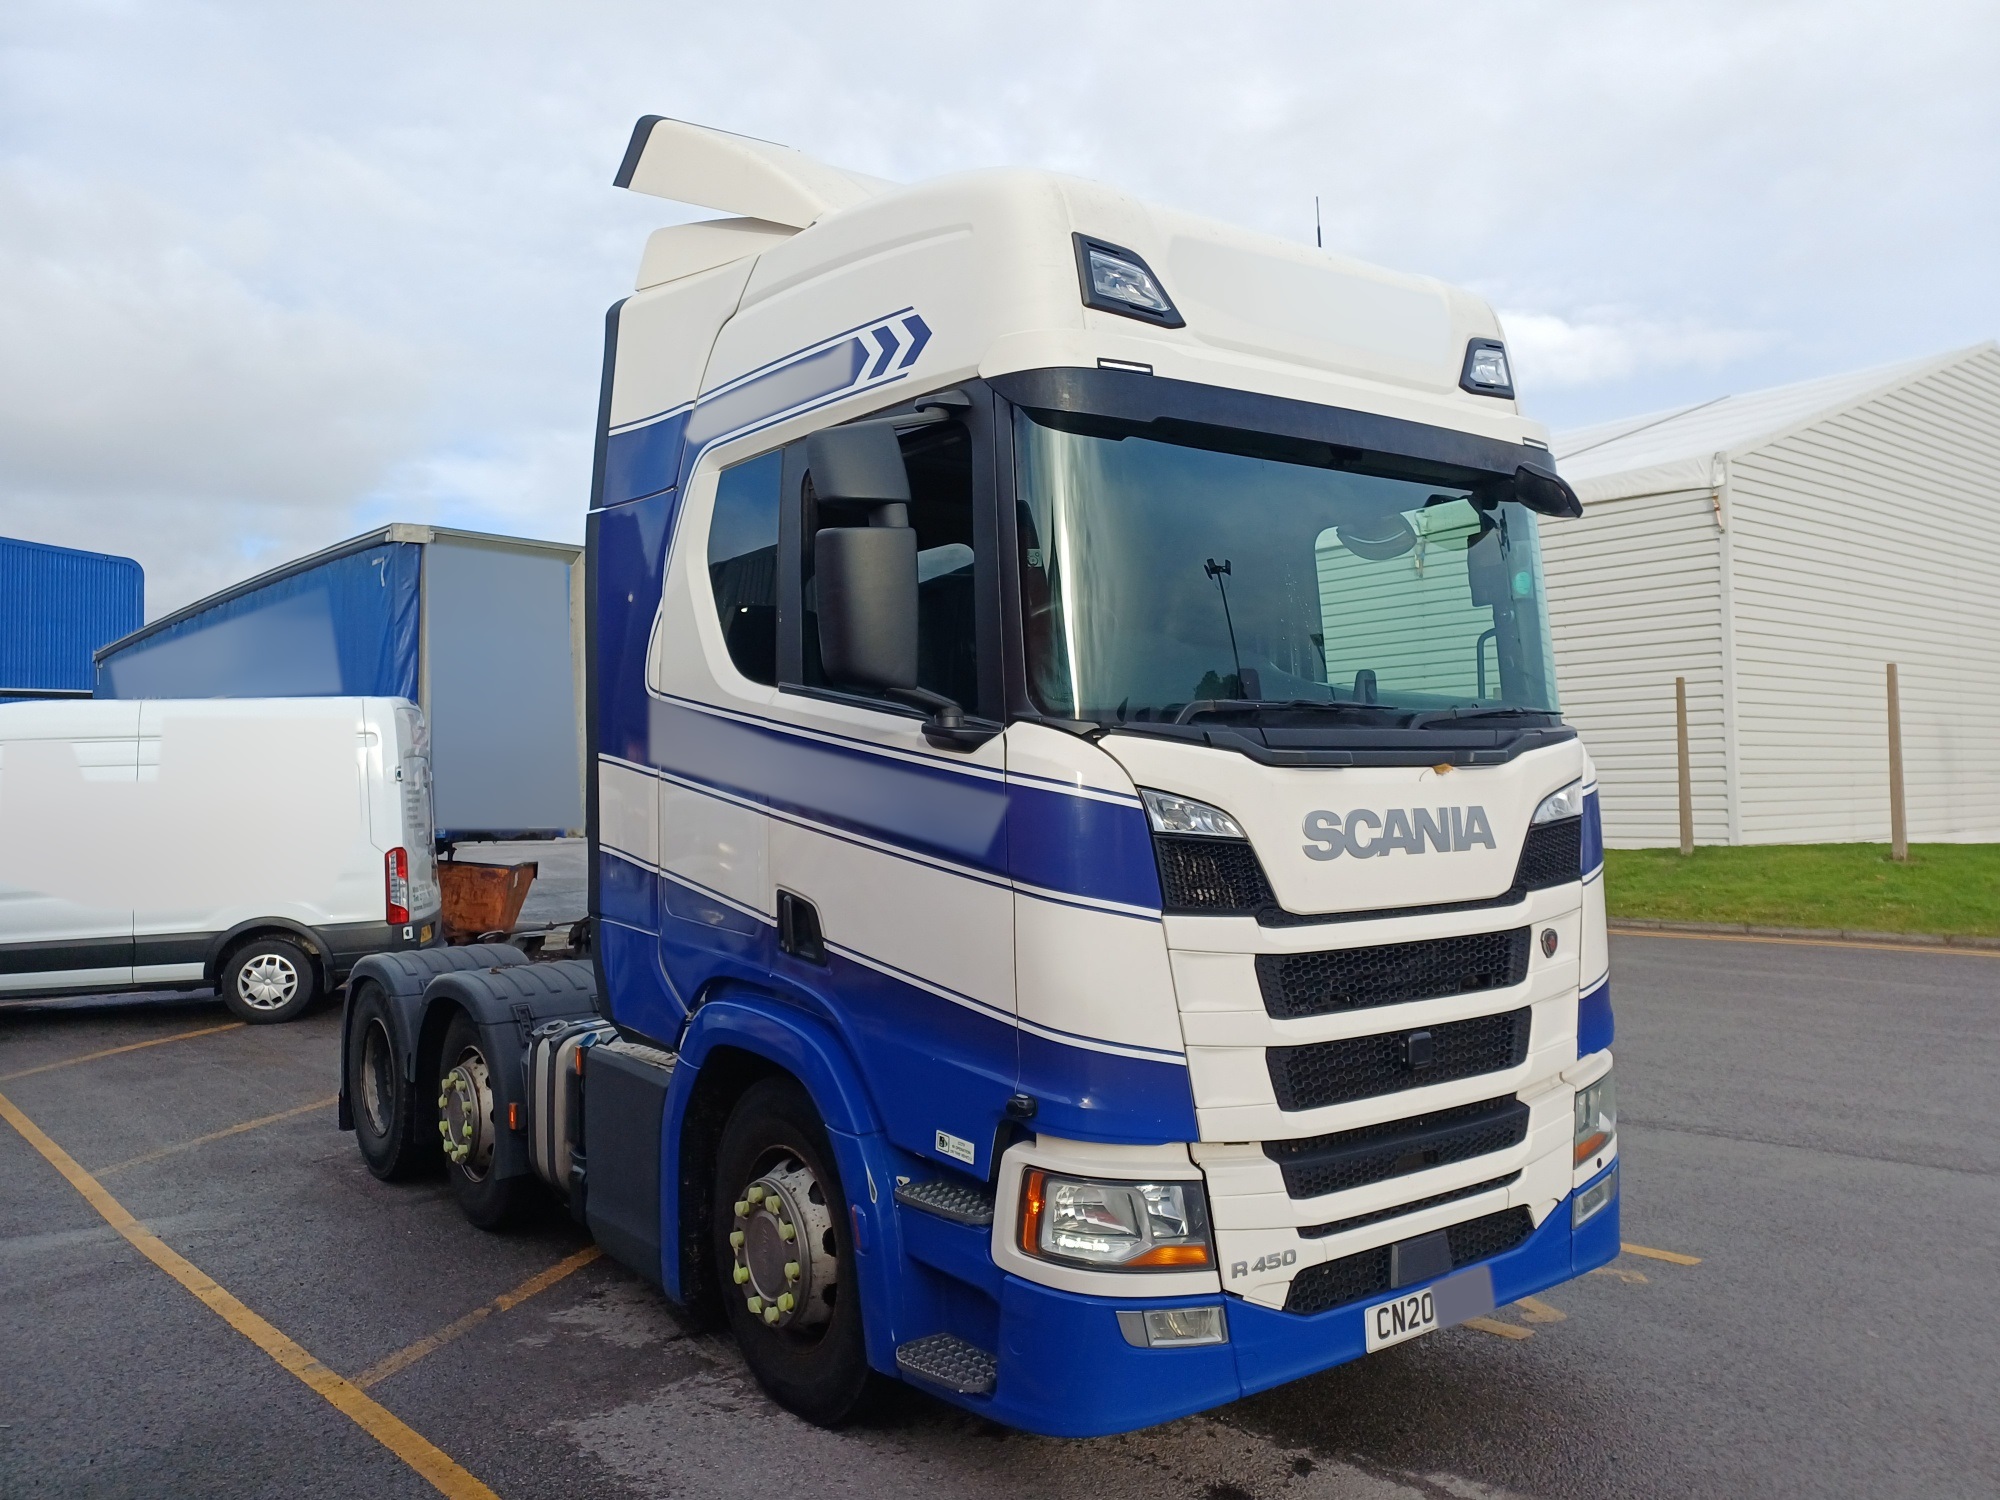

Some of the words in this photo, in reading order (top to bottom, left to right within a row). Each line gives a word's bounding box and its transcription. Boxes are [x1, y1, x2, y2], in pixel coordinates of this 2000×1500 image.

[1302, 805, 1497, 861] SCANIA
[1231, 1260, 1248, 1279] R
[1251, 1248, 1297, 1272] 450
[1376, 1292, 1434, 1340] CN20
